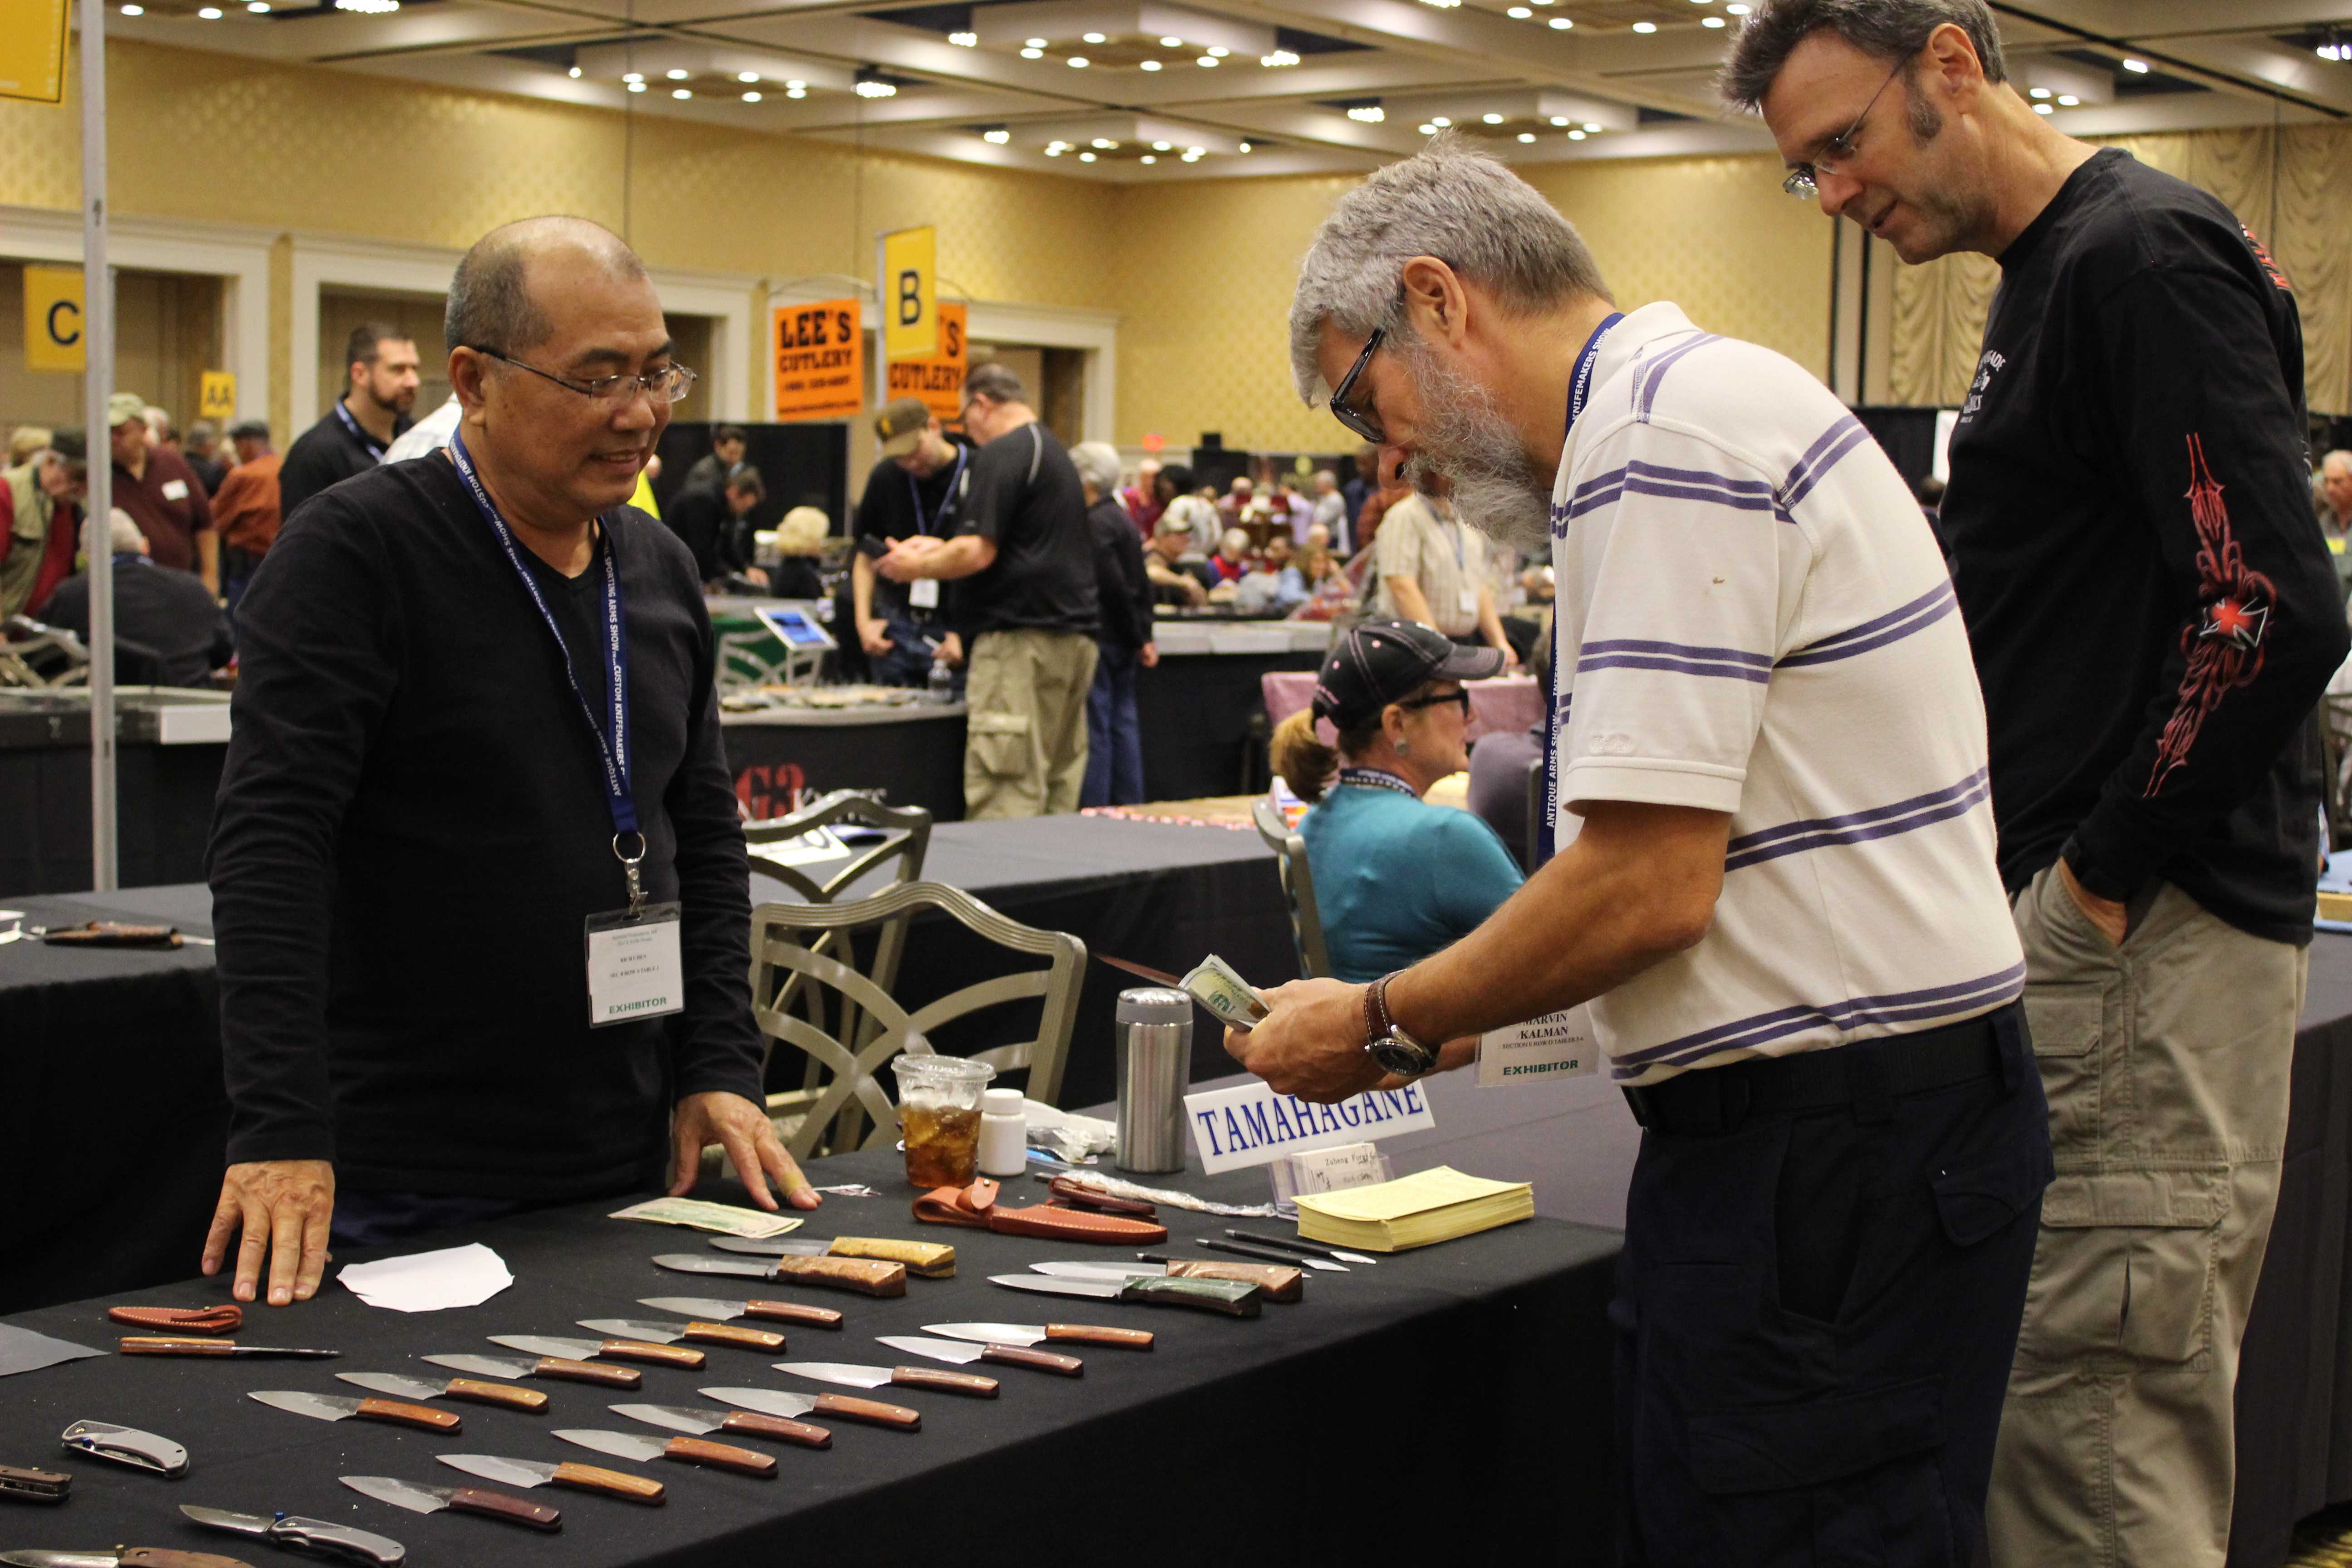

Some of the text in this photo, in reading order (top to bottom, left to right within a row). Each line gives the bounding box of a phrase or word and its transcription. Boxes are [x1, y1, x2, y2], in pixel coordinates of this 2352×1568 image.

[900, 270, 921, 325] B
[47, 301, 79, 345] C
[781, 310, 851, 348] LEE'S
[779, 349, 852, 373] CUTLERY
[890, 362, 960, 391] CUTLERY
[1572, 328, 1610, 421] KNIFEMAKERS SHOW
[468, 475, 489, 508] CUSTOM
[494, 520, 511, 546] SHOW
[604, 556, 616, 598] SPORTING
[608, 599, 617, 623] ARMS
[610, 624, 620, 652] SHOW
[613, 665, 622, 701] CUSTOM
[596, 730, 609, 755] ARMS
[615, 703, 625, 765] KNIFEMAKERS
[605, 756, 622, 796] ANTIQUE
[1549, 749, 1558, 777] ARMS
[1546, 780, 1557, 828] ANTIQUE
[609, 997, 666, 1014] EXHIBITOR
[1520, 1026, 1568, 1039] KALMAN
[1503, 1060, 1579, 1075] EXHIBITOR
[1197, 1087, 1424, 1156] TAMAHAGANE
